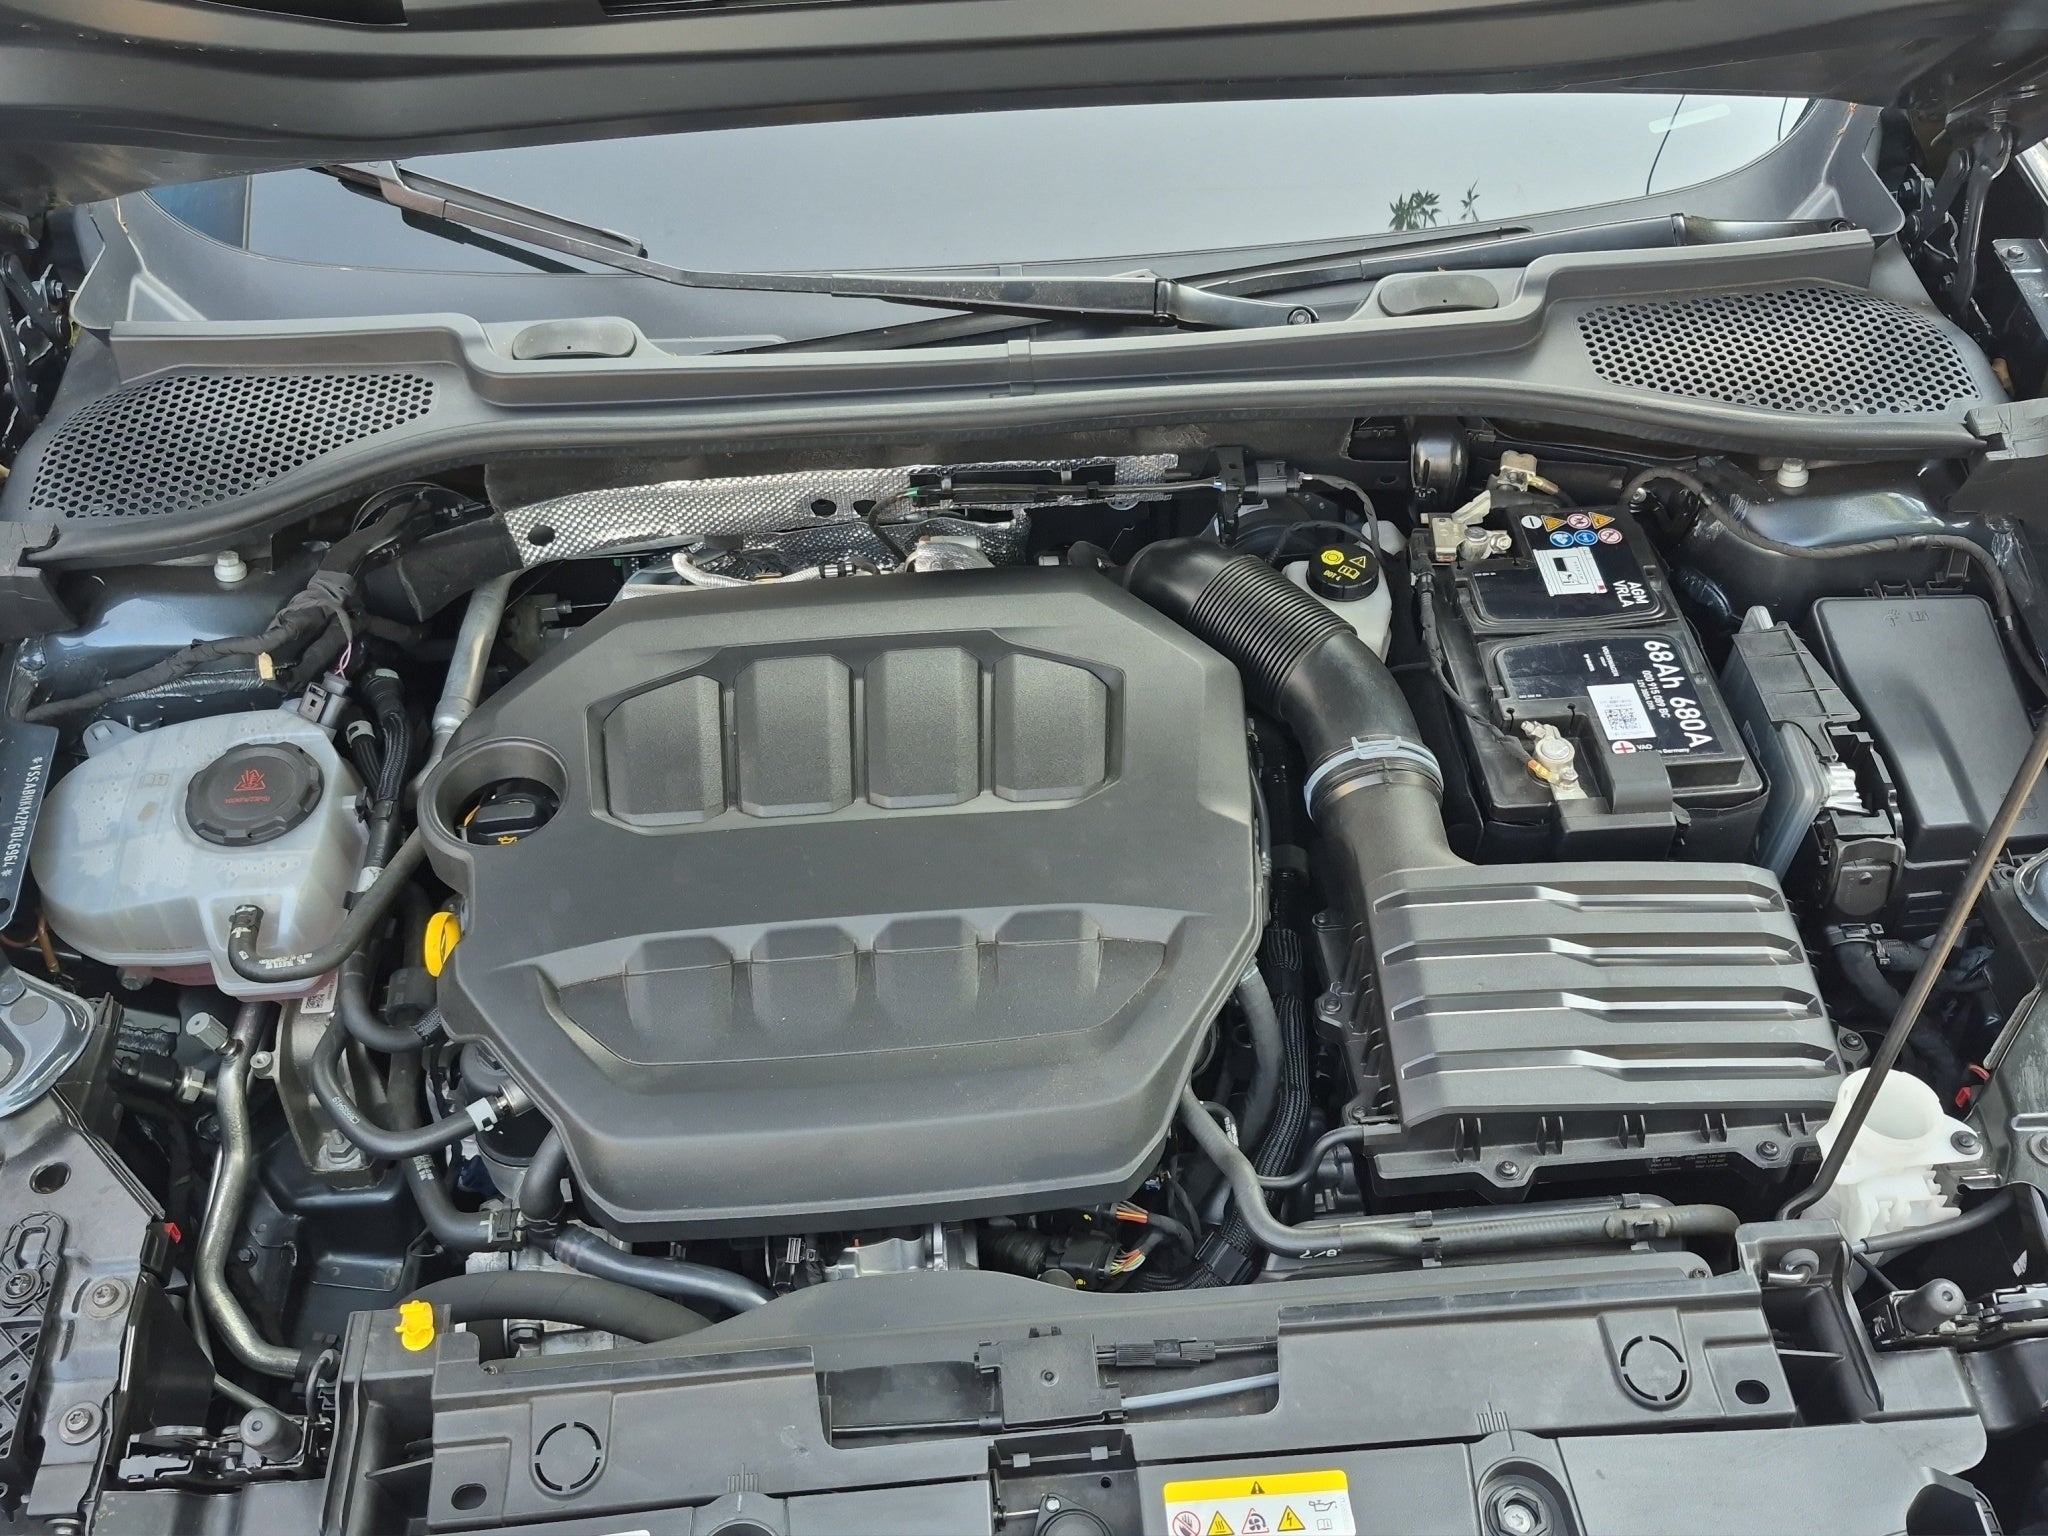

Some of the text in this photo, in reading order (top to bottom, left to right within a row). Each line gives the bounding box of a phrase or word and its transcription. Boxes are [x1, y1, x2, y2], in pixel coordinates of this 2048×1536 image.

[1612, 579, 1635, 608] VRLA
[1627, 581, 1650, 604] AGM
[1643, 640, 1713, 748] 68Ah 680A
[1646, 682, 1661, 694] 915
[1658, 707, 1671, 719] BC
